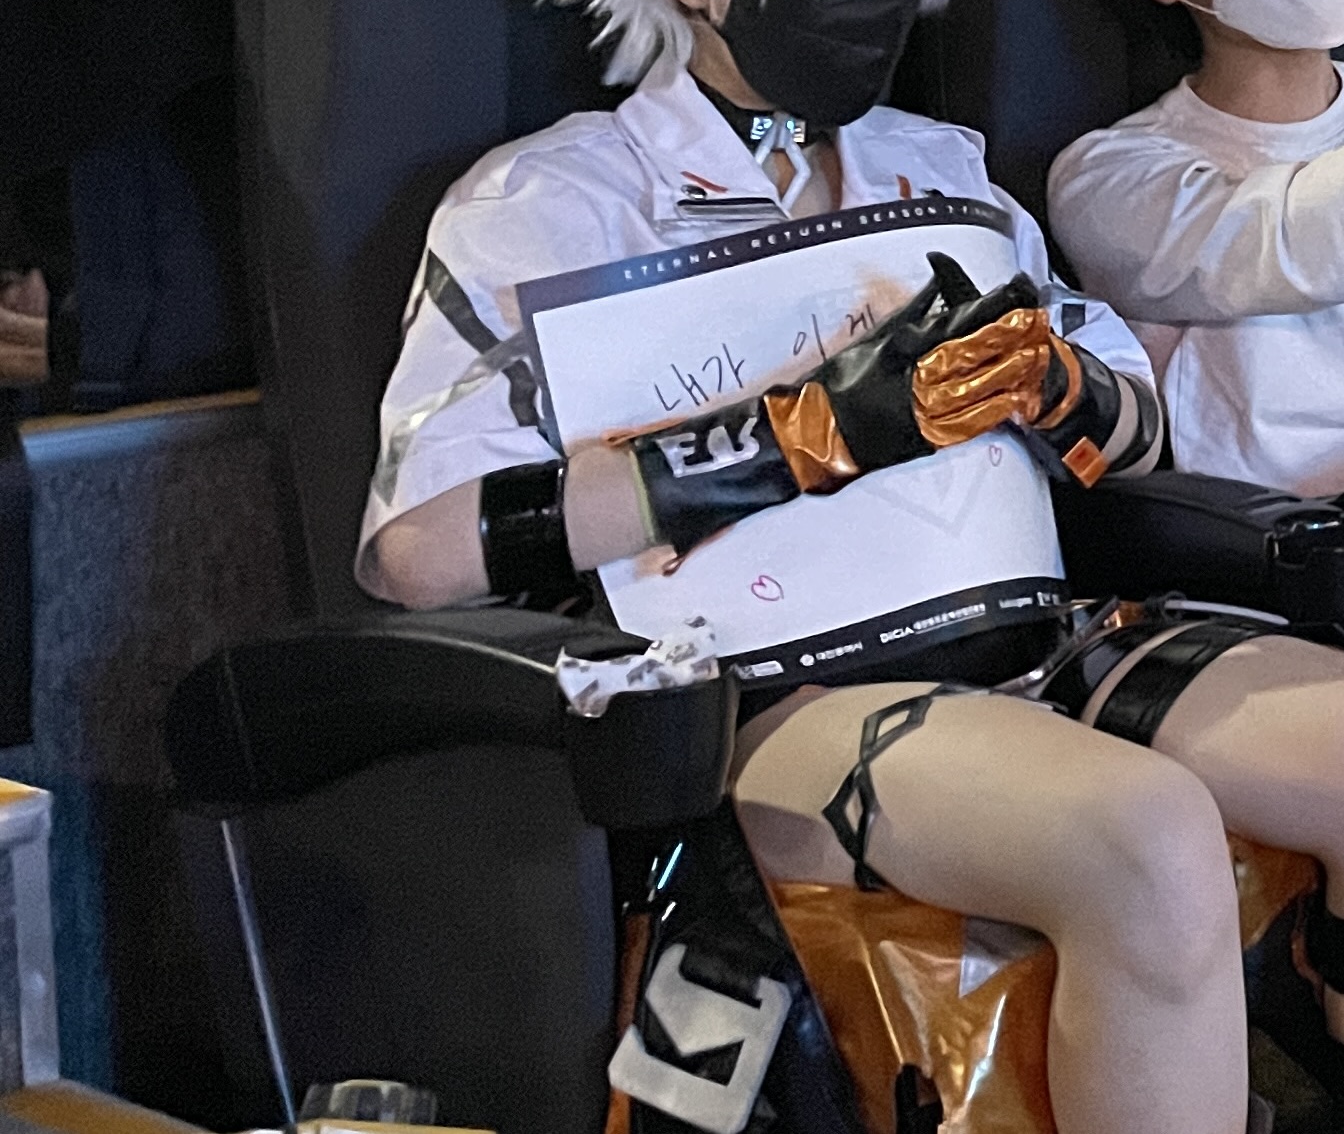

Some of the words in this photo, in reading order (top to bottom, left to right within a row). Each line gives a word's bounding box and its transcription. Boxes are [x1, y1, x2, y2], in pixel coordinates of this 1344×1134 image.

[624, 246, 733, 280] ETERNAL
[750, 220, 844, 250] RETURN
[859, 205, 937, 226] SEASON
[653, 342, 746, 412] 내가
